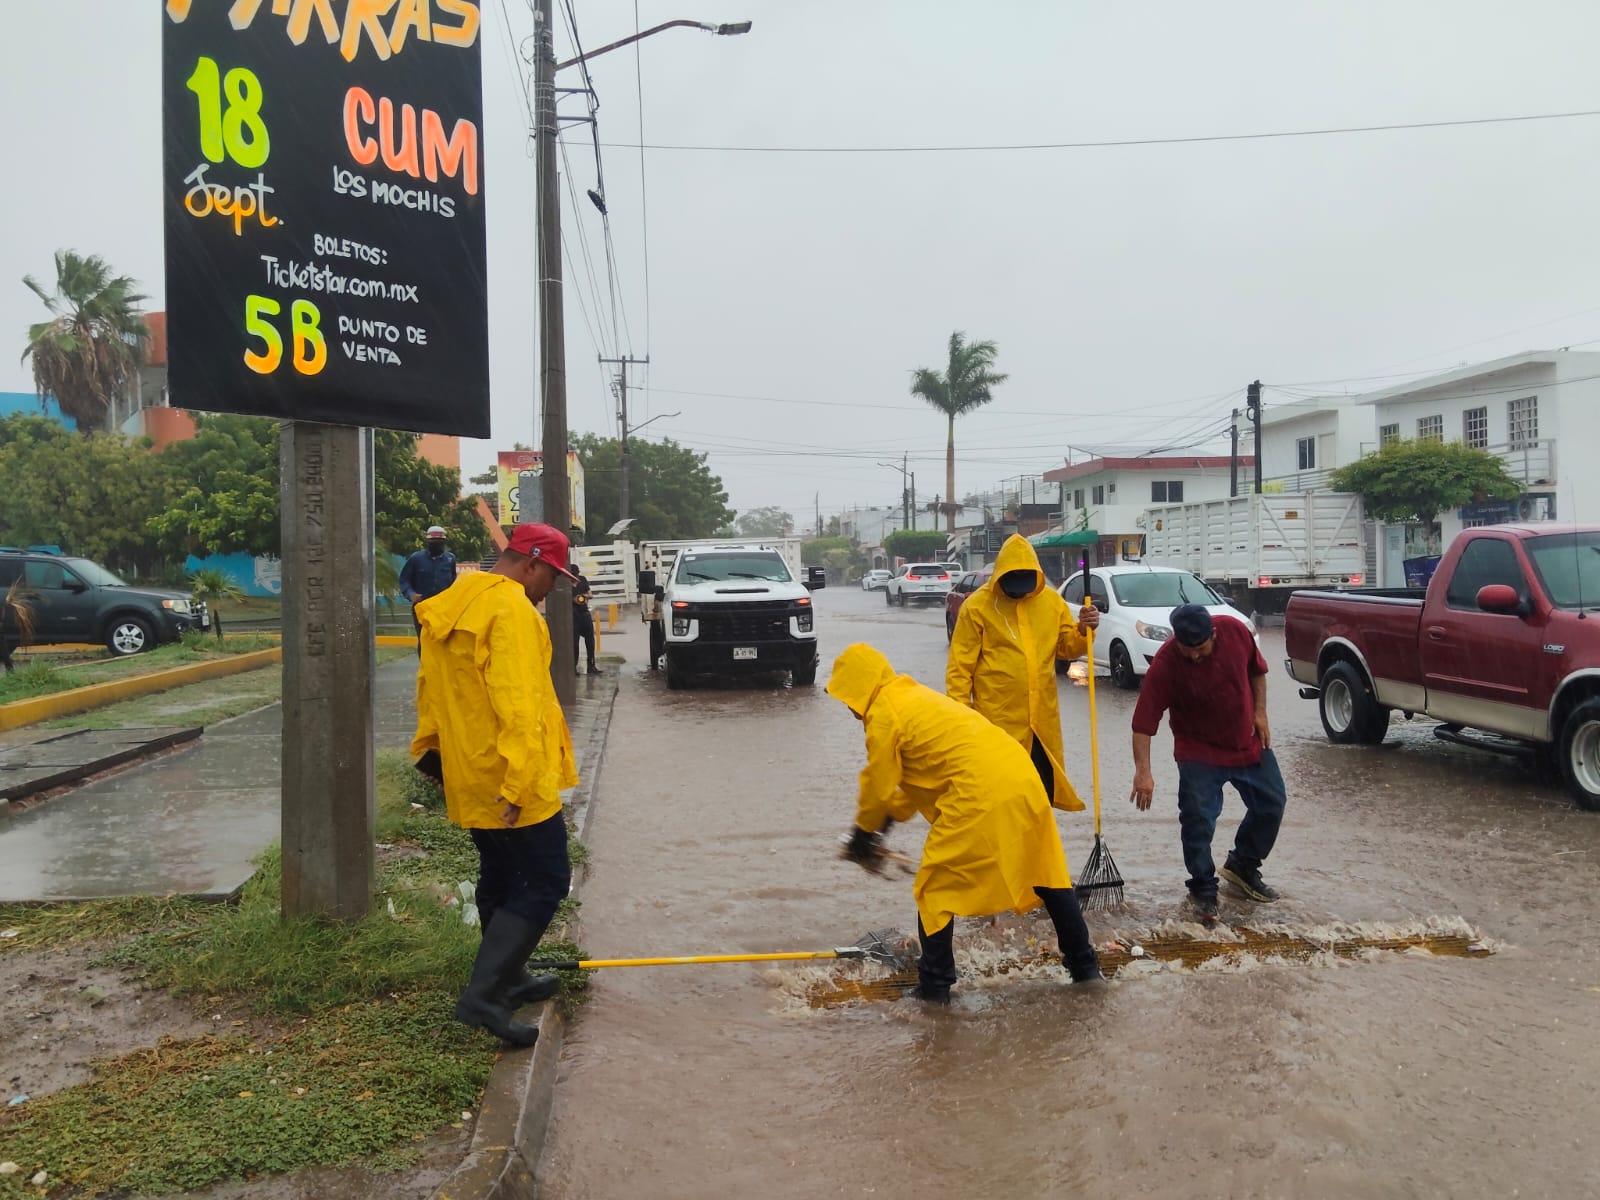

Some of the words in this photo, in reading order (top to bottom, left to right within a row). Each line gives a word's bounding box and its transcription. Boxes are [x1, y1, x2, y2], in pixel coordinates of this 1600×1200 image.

[166, 0, 480, 62] RAS
[186, 56, 270, 168] 18
[343, 86, 478, 196] CUM
[333, 165, 367, 197] LOS
[372, 180, 455, 217] MOCHIS
[314, 234, 388, 265] BOLETOS:
[260, 254, 418, 303] Ticketstar.com.mx
[339, 316, 400, 343] PUNTO
[406, 326, 427, 345] DE
[342, 341, 401, 366] VENTA
